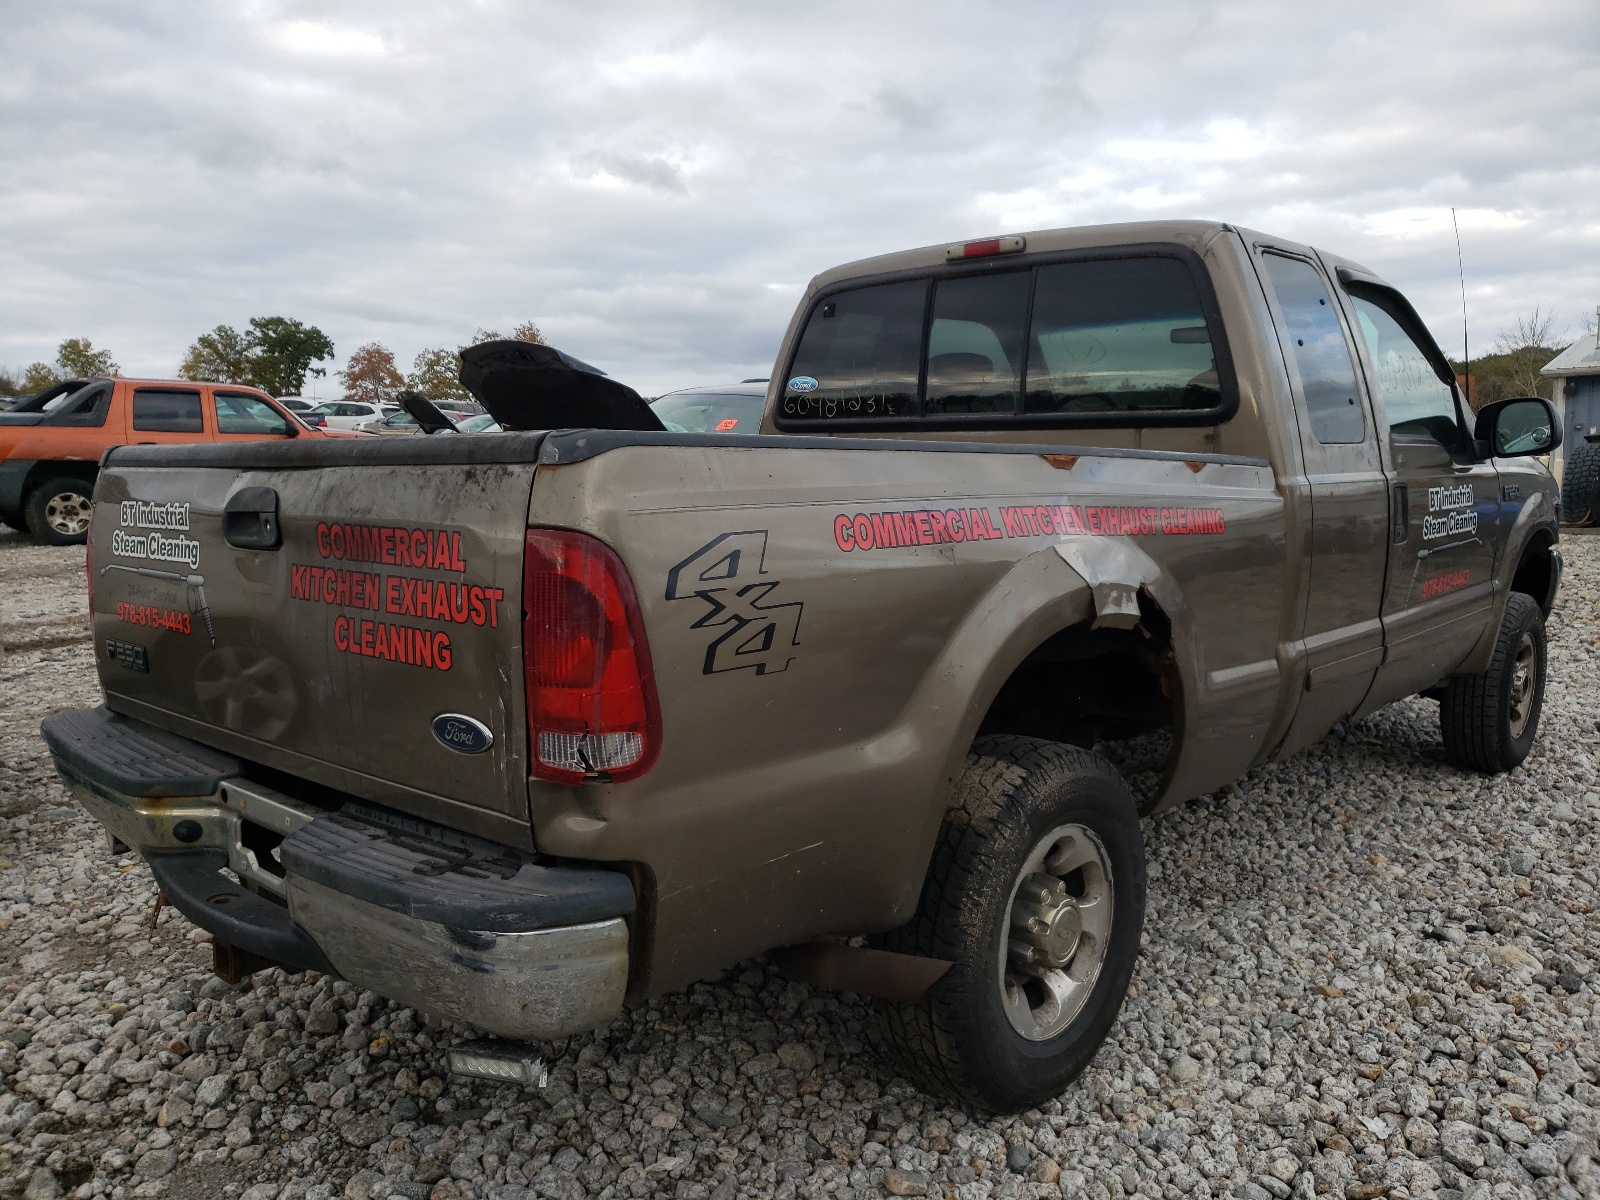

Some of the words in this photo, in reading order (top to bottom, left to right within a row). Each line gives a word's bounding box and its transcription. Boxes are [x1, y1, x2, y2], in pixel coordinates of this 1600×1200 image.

[120, 501, 137, 527] BT
[136, 501, 190, 530] Industrial
[1429, 487, 1441, 512] BT
[1440, 483, 1474, 509] Industrial
[834, 507, 1003, 552] COMMERCIAL
[1000, 505, 1087, 538] KITCHEN
[1086, 506, 1157, 536] EXHAUST
[1160, 507, 1225, 535] CLEANING
[1423, 514, 1447, 540] Steam
[1447, 509, 1478, 535] Cleaning
[113, 530, 147, 558] Steam
[148, 531, 200, 569] Cleaning
[316, 521, 466, 573] COMMERCIAL
[290, 563, 381, 612] KITCHEN
[386, 574, 504, 628] EXHAUST
[117, 601, 191, 635] 978-815-4443
[334, 614, 453, 671] CLEANING
[444, 720, 475, 745] Ford
